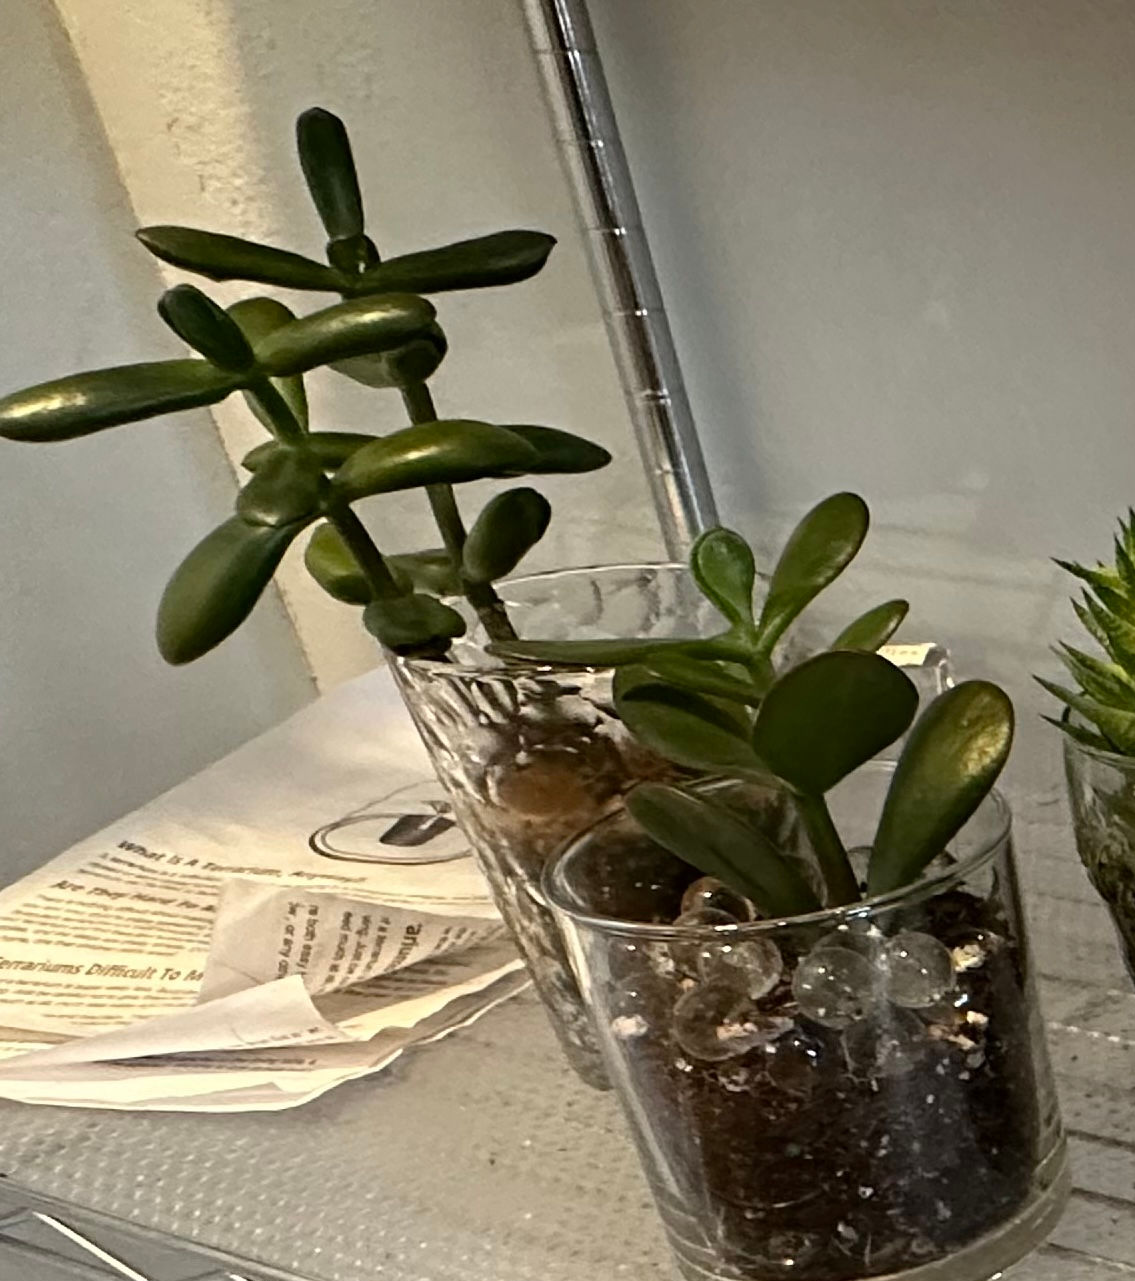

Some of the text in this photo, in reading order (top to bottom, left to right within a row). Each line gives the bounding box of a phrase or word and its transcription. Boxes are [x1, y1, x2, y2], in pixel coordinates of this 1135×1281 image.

[117, 840, 166, 861] What
[183, 858, 199, 867] A
[85, 962, 158, 980] Difficult
[160, 968, 182, 981] To
